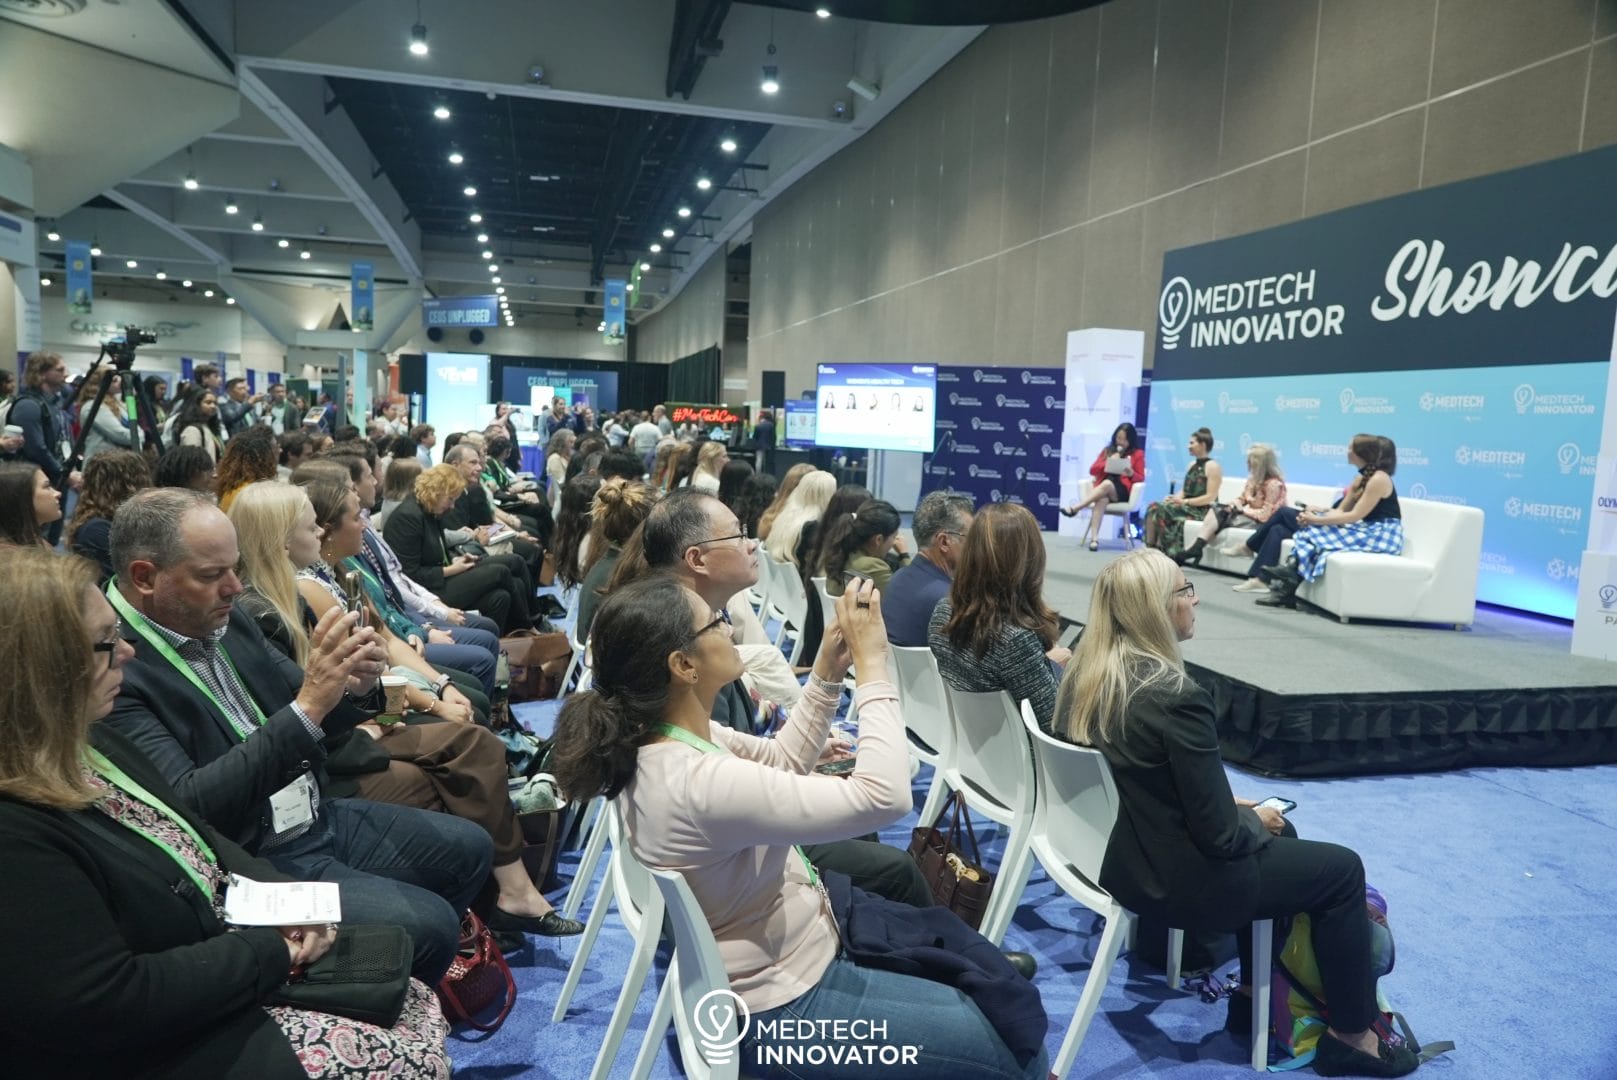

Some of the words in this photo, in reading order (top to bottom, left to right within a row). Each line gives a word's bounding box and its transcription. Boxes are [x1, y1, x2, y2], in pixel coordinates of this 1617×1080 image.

[1193, 269, 1316, 316] MEDTECH
[448, 309, 491, 324] UNPLUGGED
[1190, 304, 1346, 349] INNOVATOR
[1435, 396, 1485, 410] MEDTECH
[1534, 395, 1585, 405] MEDTECH
[1534, 404, 1595, 415] INNOVATOR
[1471, 451, 1526, 465] MEDTECH
[1522, 502, 1582, 521] MEDTECH
